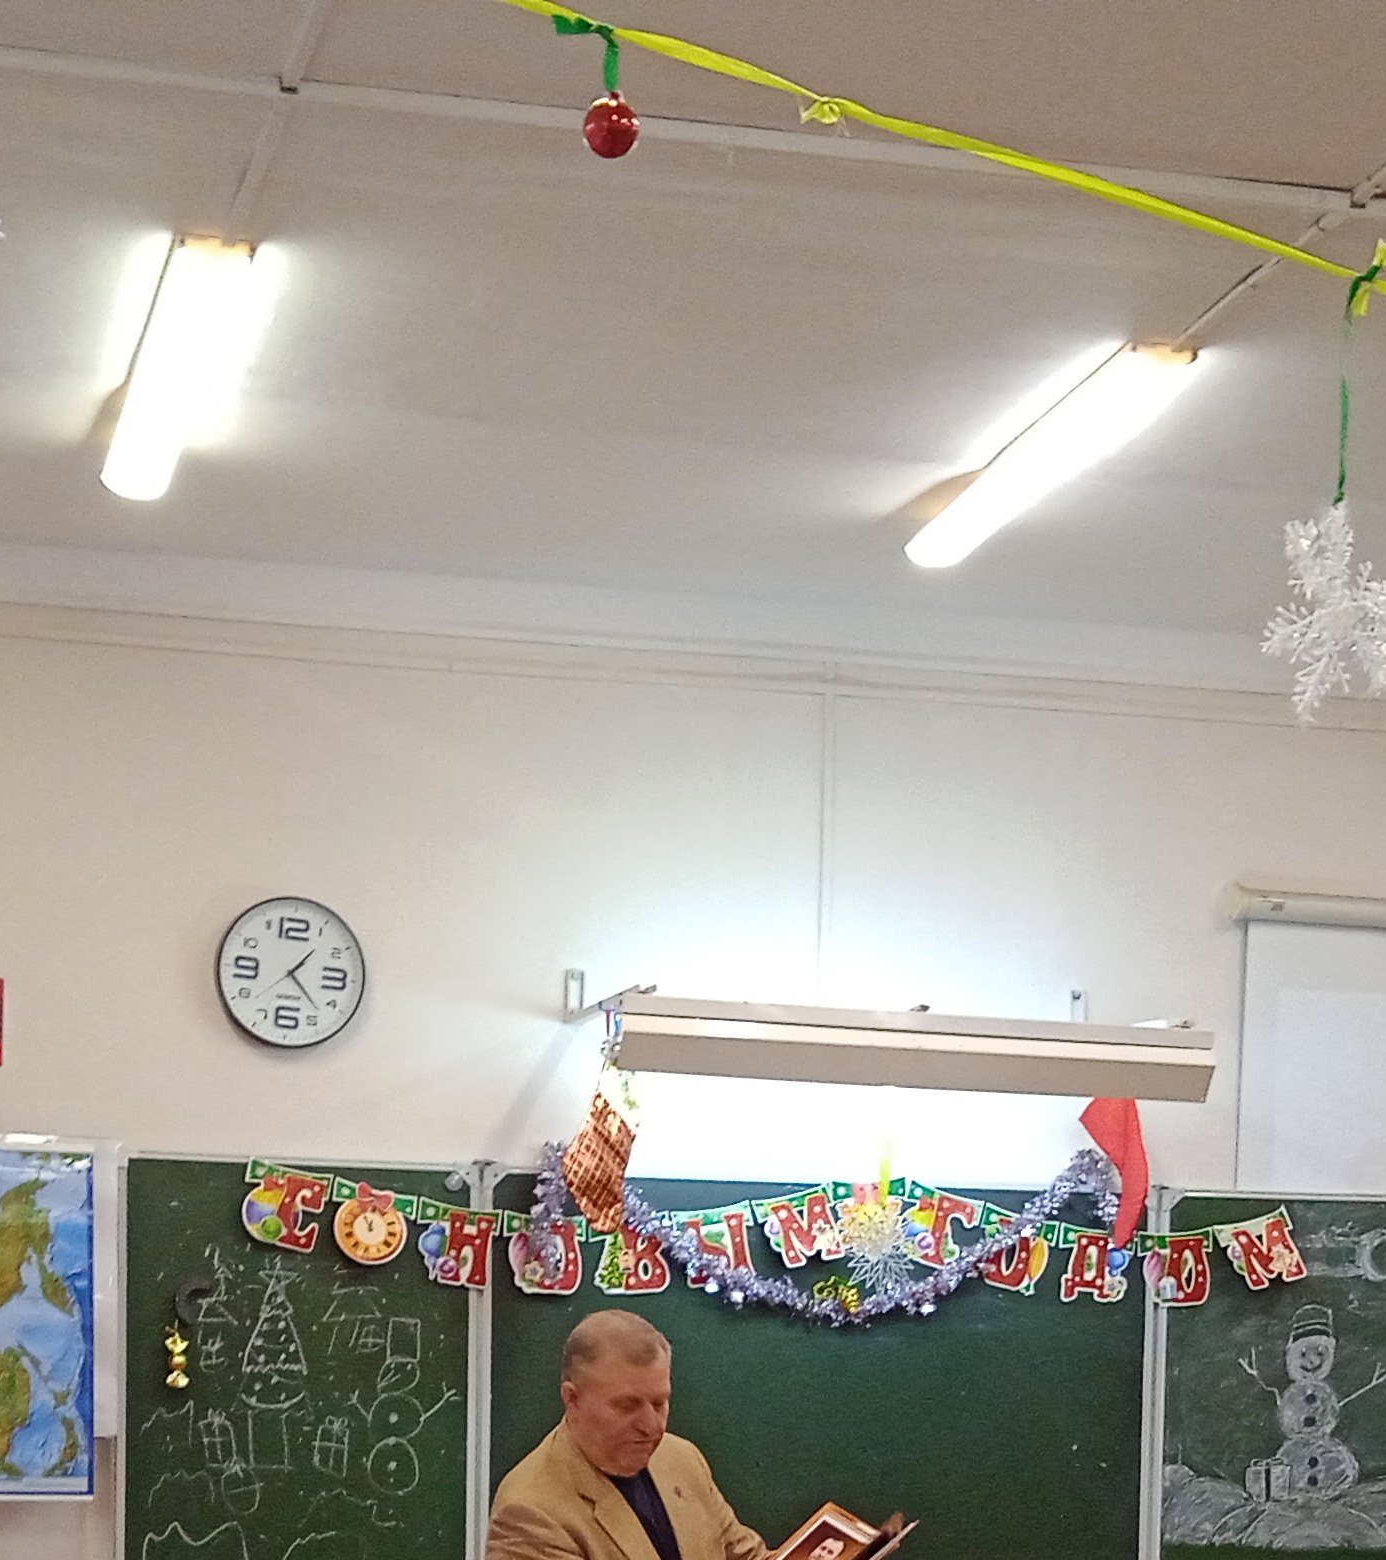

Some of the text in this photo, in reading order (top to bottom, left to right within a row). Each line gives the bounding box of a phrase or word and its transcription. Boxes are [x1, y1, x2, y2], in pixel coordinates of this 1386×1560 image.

[278, 917, 310, 942] 12
[233, 955, 260, 980] 9
[320, 966, 348, 991] 3
[274, 1005, 301, 1030] 6
